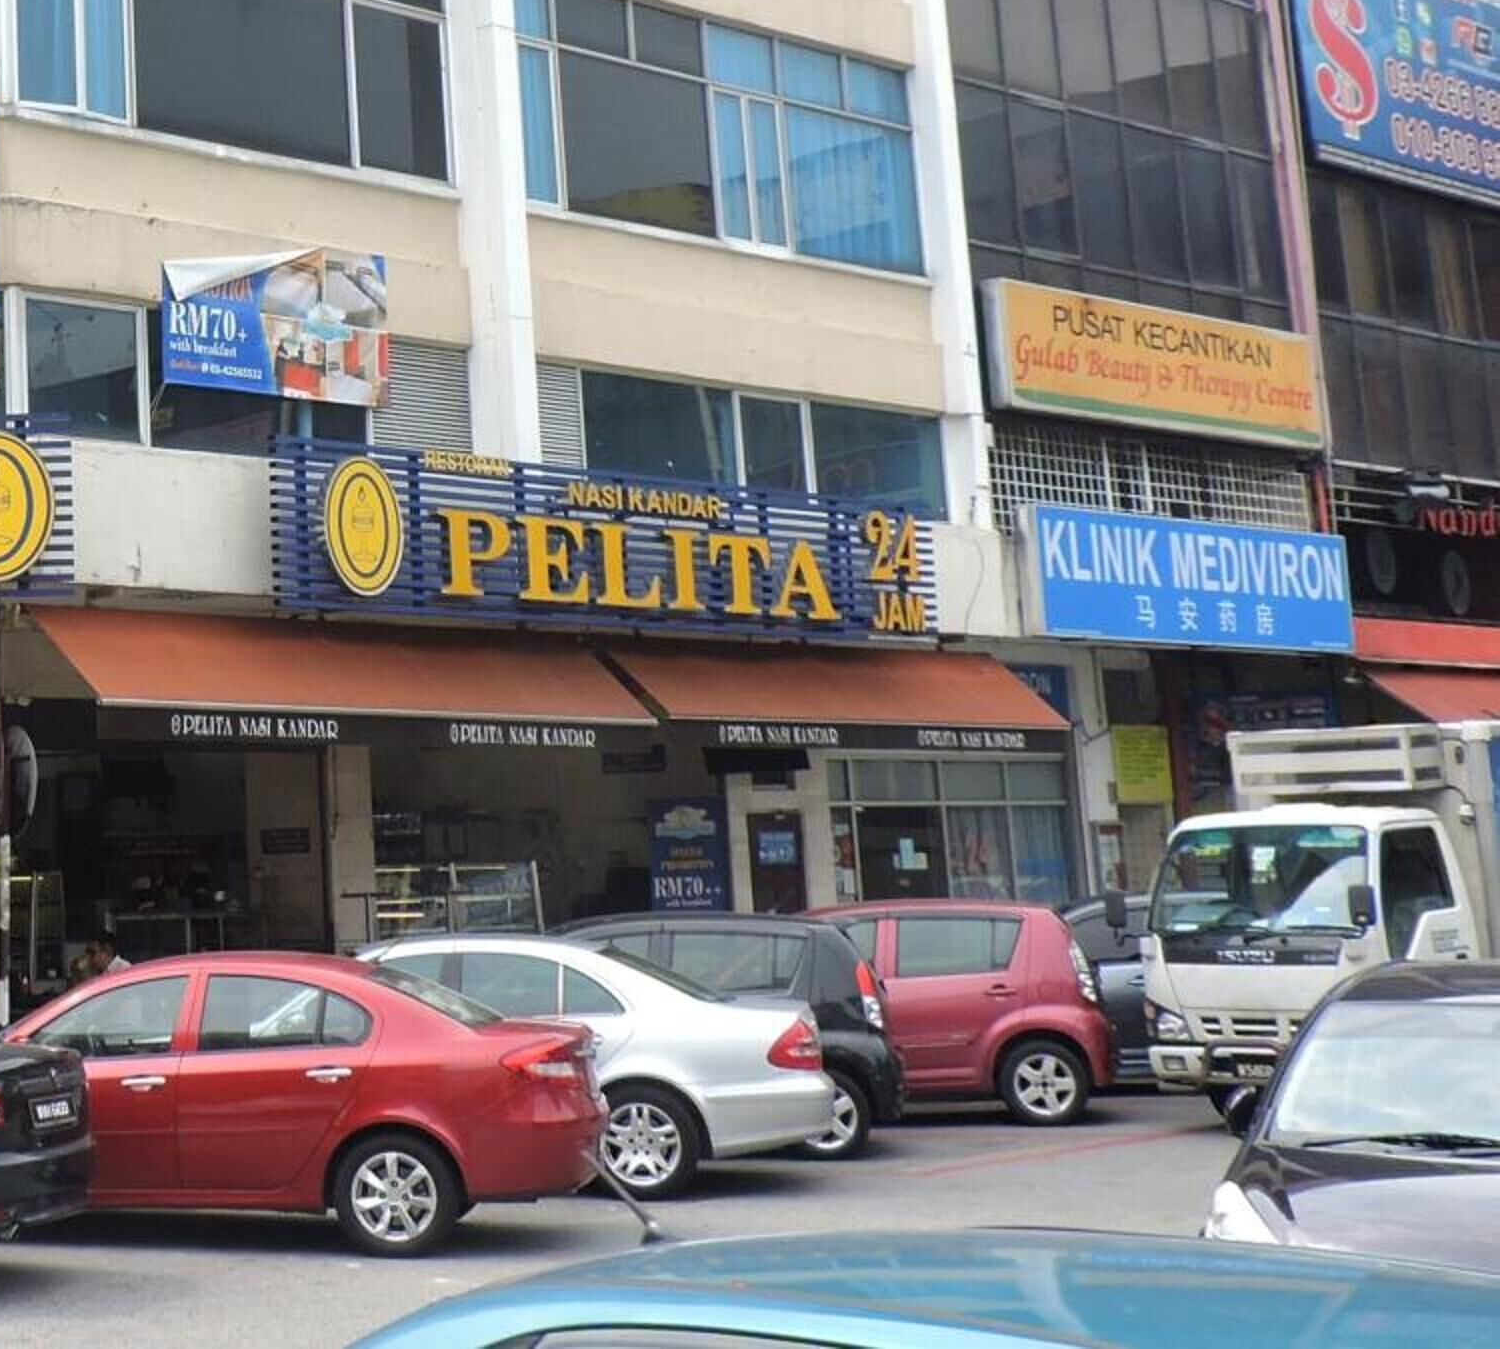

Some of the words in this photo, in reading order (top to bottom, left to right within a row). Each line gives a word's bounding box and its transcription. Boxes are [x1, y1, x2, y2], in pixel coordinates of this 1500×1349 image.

[169, 336, 191, 352] with
[193, 338, 237, 358] breakfast
[1053, 304, 1125, 343] PUSAT
[1133, 319, 1273, 369] KECANTIKAN
[1015, 333, 1080, 381] Gulab
[1085, 348, 1151, 398] Beauty
[1156, 364, 1175, 390] &
[1181, 362, 1252, 415] Therapy
[1255, 378, 1314, 411] Centre
[424, 450, 509, 477] RESTORAN
[568, 481, 622, 511] NASI
[628, 487, 724, 521] KANDAR
[437, 507, 844, 623] PELITA
[864, 509, 920, 585] 24
[1041, 518, 1161, 588] KLINIK
[1168, 534, 1345, 603] MEDIVIRON
[873, 591, 928, 635] JAM
[183, 719, 233, 737] PELITA
[239, 720, 271, 738] NASI
[277, 719, 339, 740] KANDAR
[461, 724, 504, 744] PELITA
[509, 725, 537, 745] NASI
[543, 726, 596, 748] KANDAR
